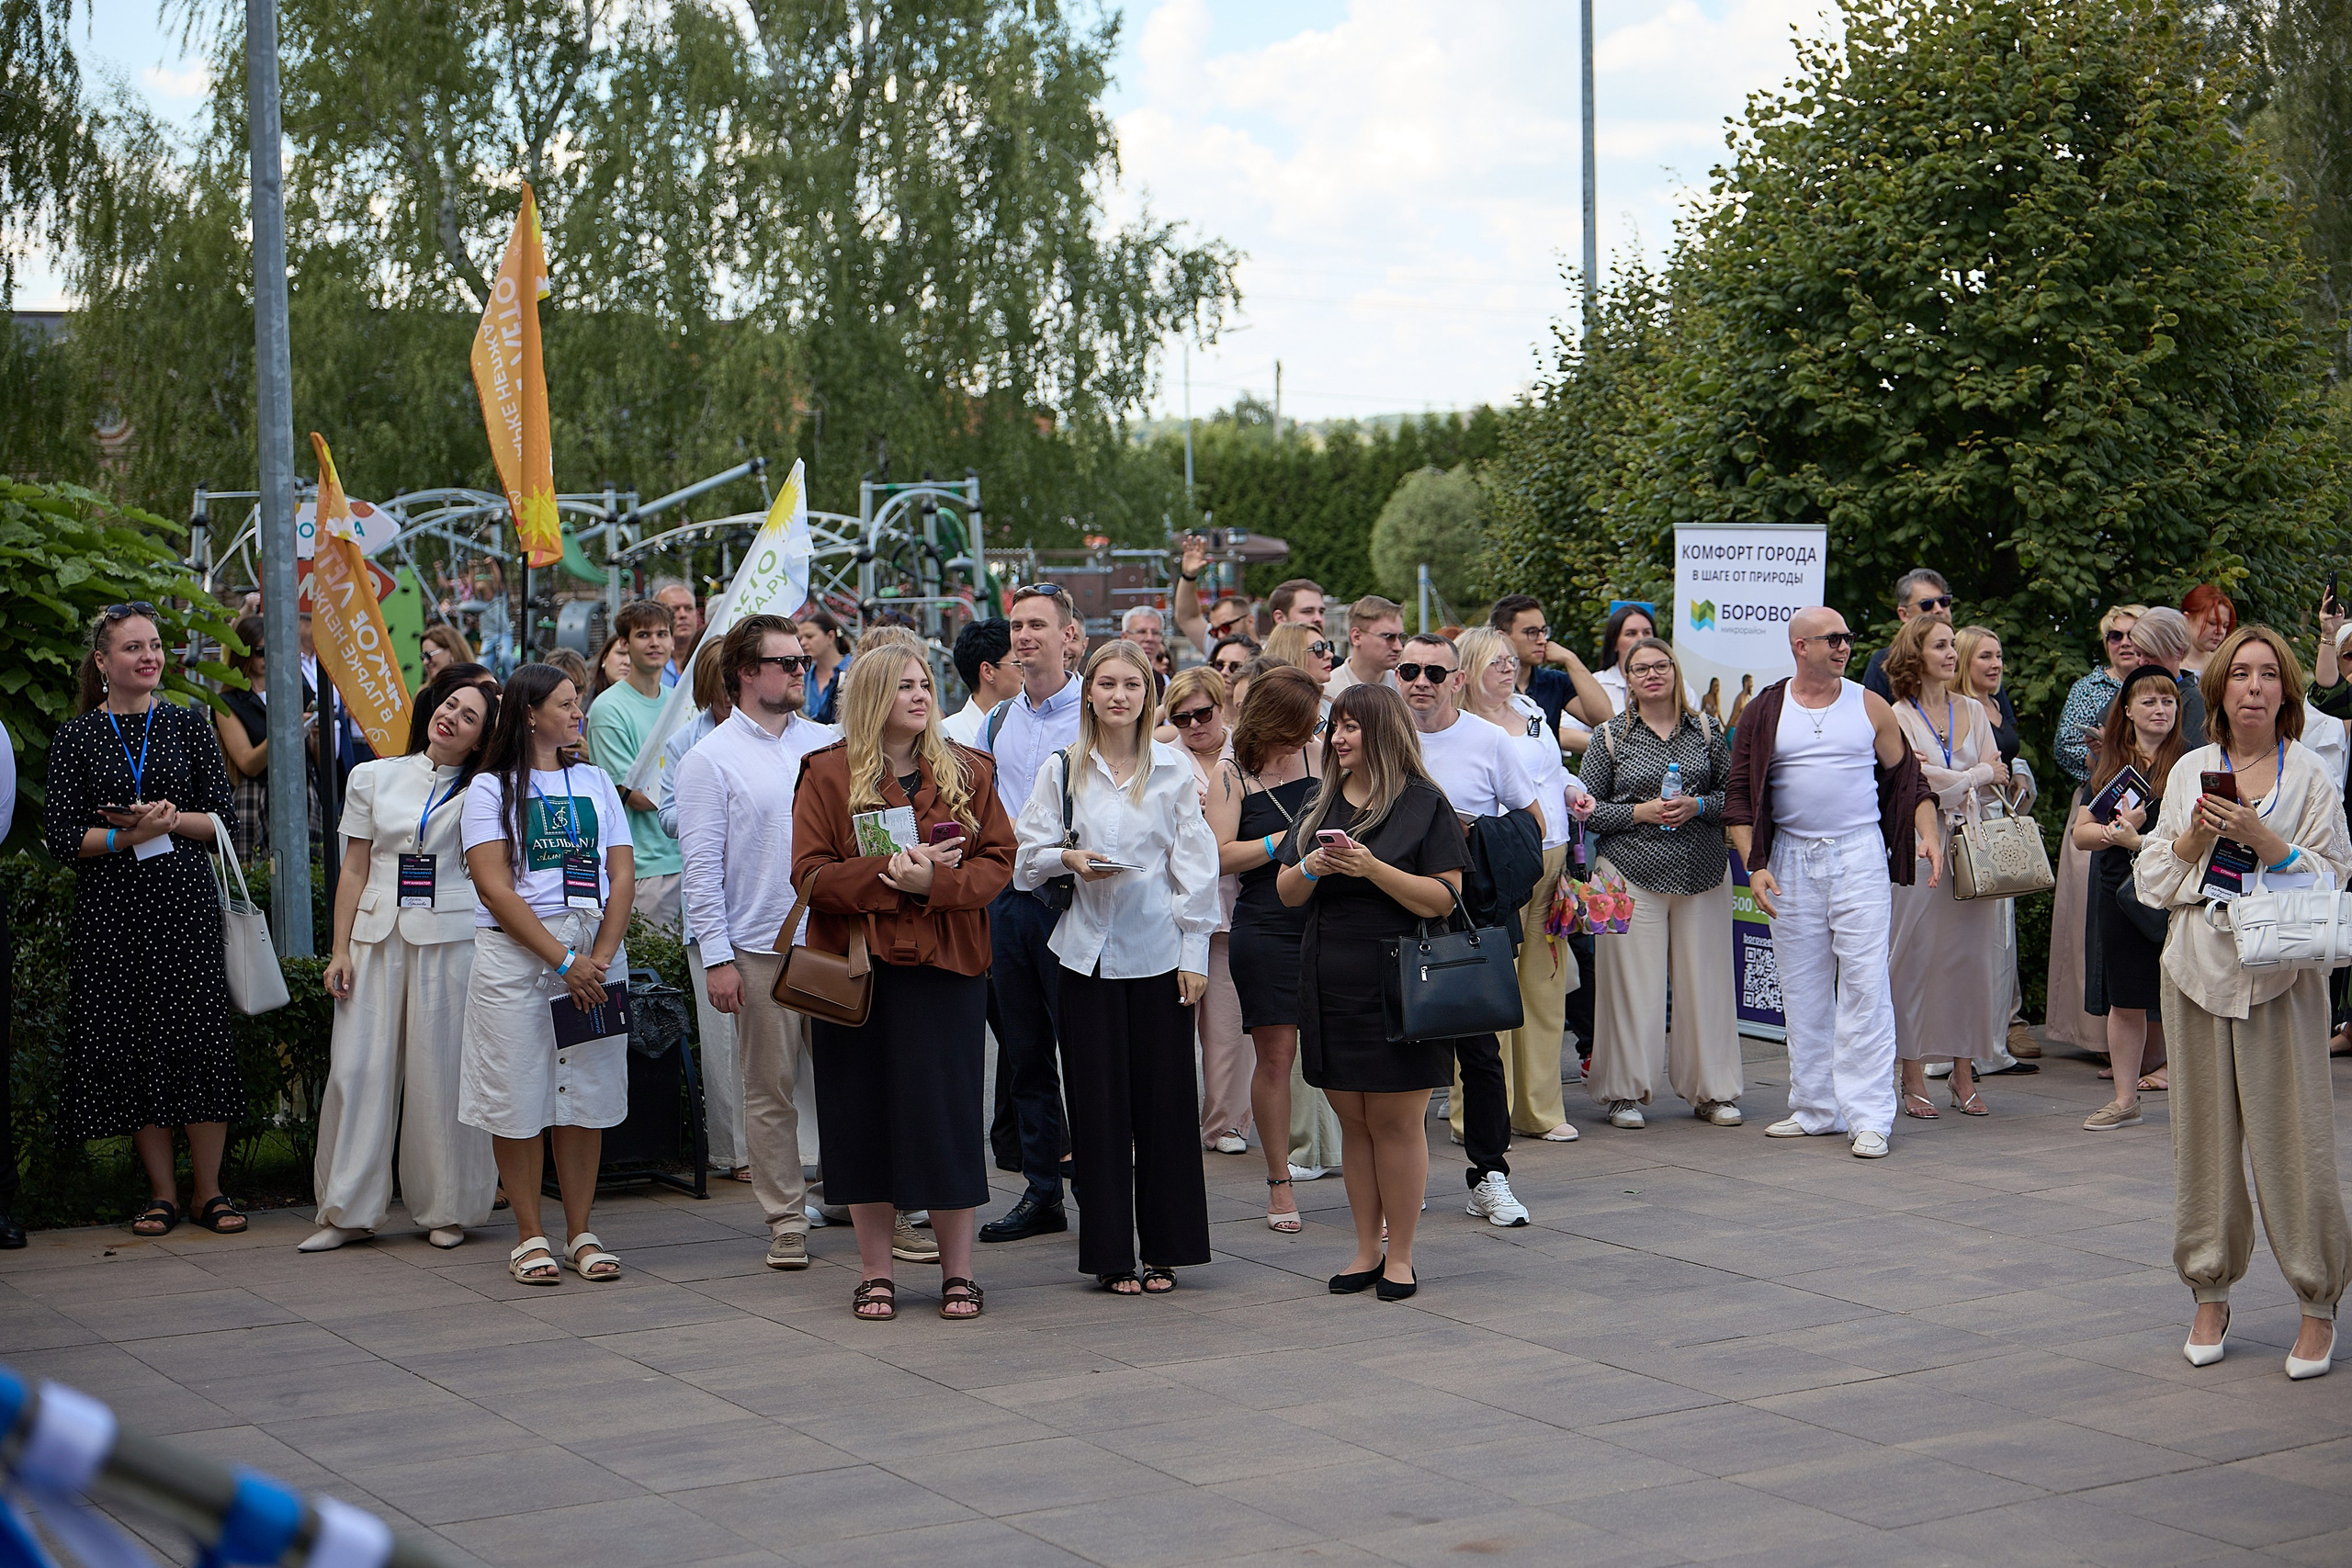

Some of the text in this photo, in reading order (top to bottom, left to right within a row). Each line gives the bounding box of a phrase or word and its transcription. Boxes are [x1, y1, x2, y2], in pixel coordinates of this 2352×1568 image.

[1682, 545, 1816, 565] КОМФОРТ ГОРОДА
[1692, 570, 1804, 586] В ШАГЕ ОТ ПРИРОДЫ
[1722, 604, 1802, 622] БОРОВО
